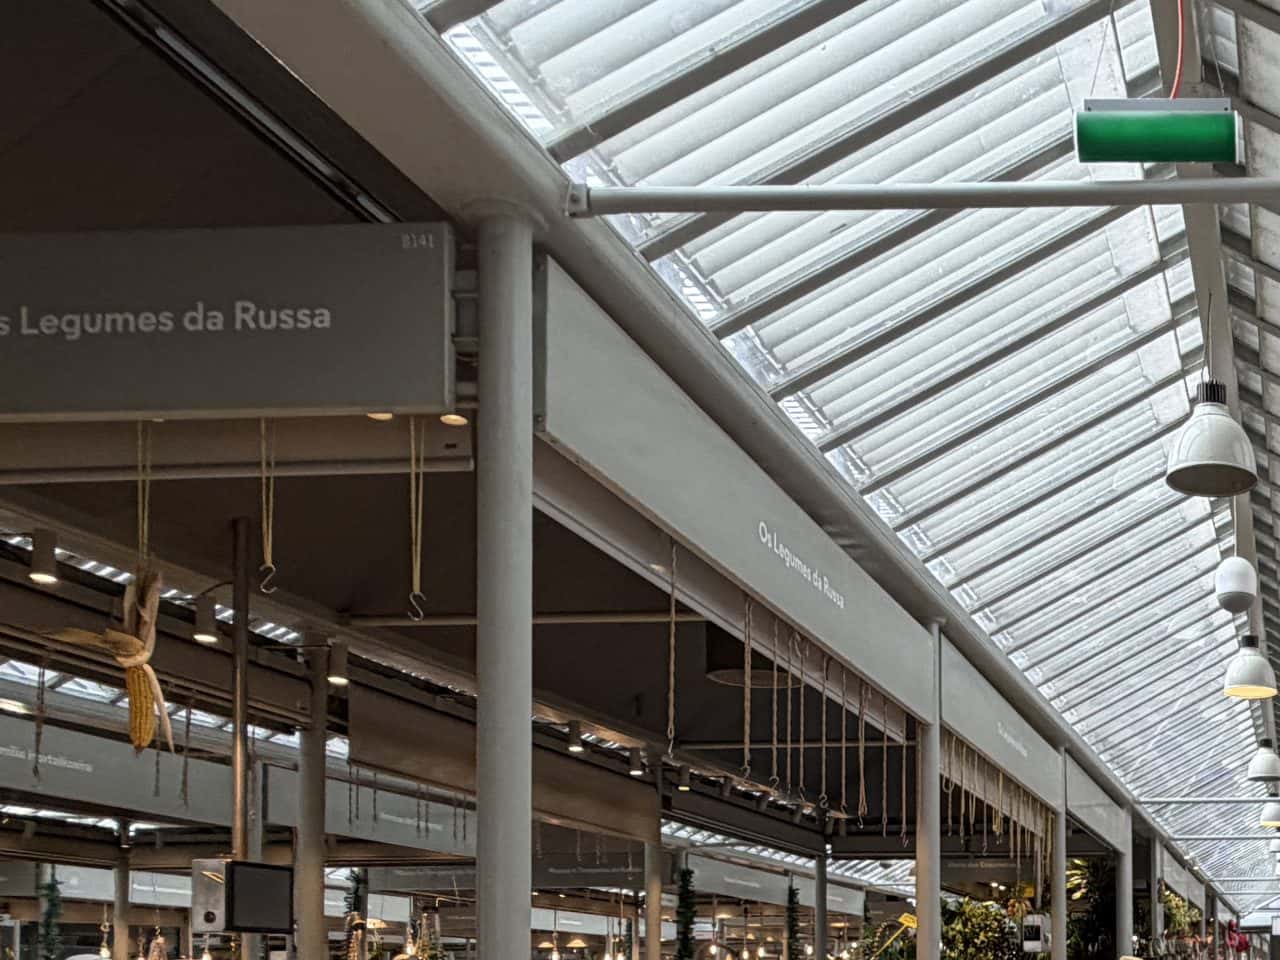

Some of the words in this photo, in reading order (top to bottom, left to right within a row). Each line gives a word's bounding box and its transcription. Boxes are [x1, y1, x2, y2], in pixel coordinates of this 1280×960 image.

[20, 305, 175, 340] Legumes
[182, 300, 225, 332] da
[234, 300, 332, 331] Russa
[758, 520, 773, 549] Os
[773, 531, 812, 582] Legumes
[812, 570, 823, 592] da
[823, 575, 845, 609] Russa
